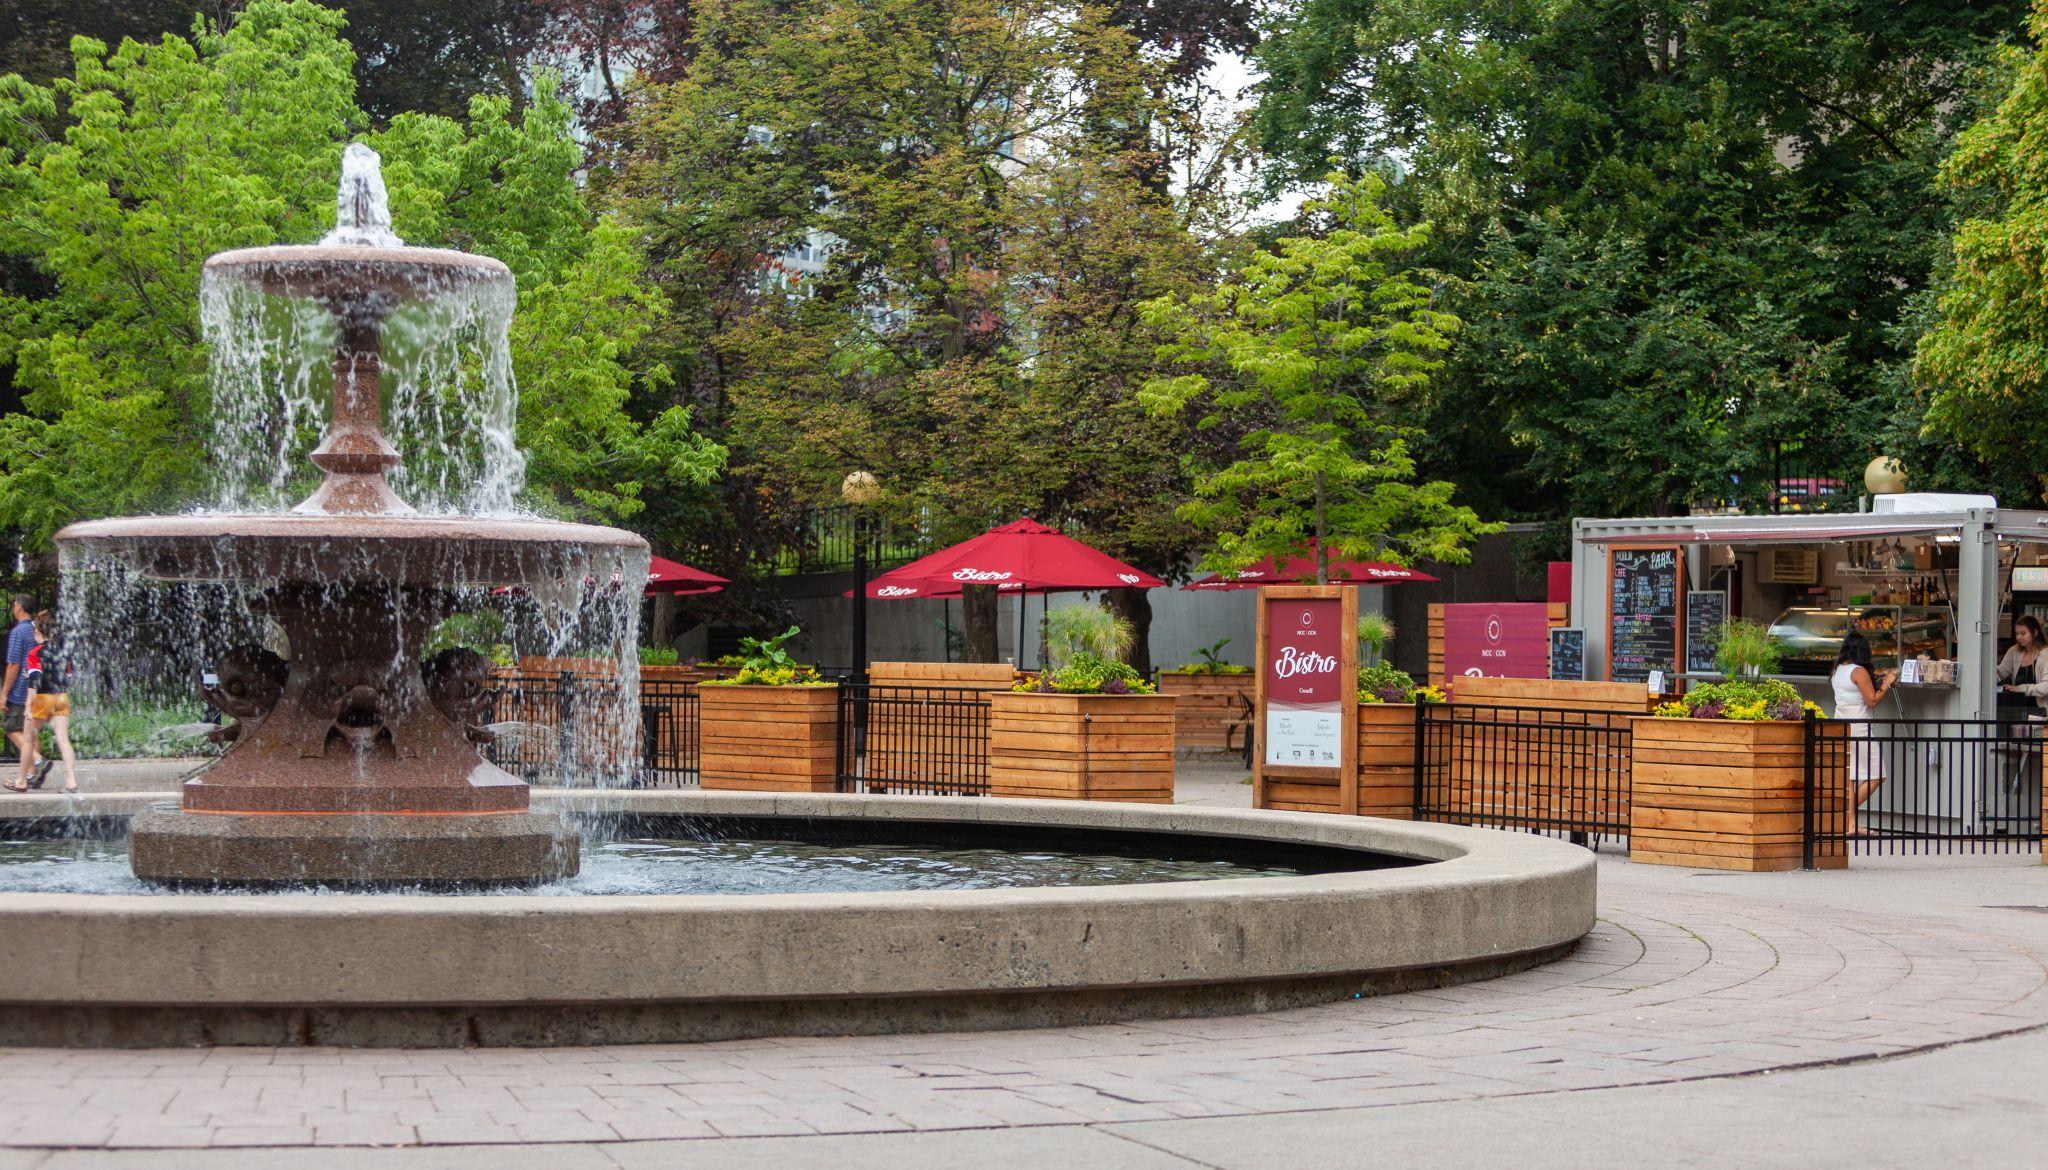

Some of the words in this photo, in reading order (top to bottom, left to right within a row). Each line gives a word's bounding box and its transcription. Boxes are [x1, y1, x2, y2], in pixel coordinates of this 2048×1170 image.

[1651, 551, 1675, 569] PARK
[952, 568, 1012, 580] Bistro
[877, 586, 918, 596] Bistro
[1275, 646, 1338, 679] Bistro
